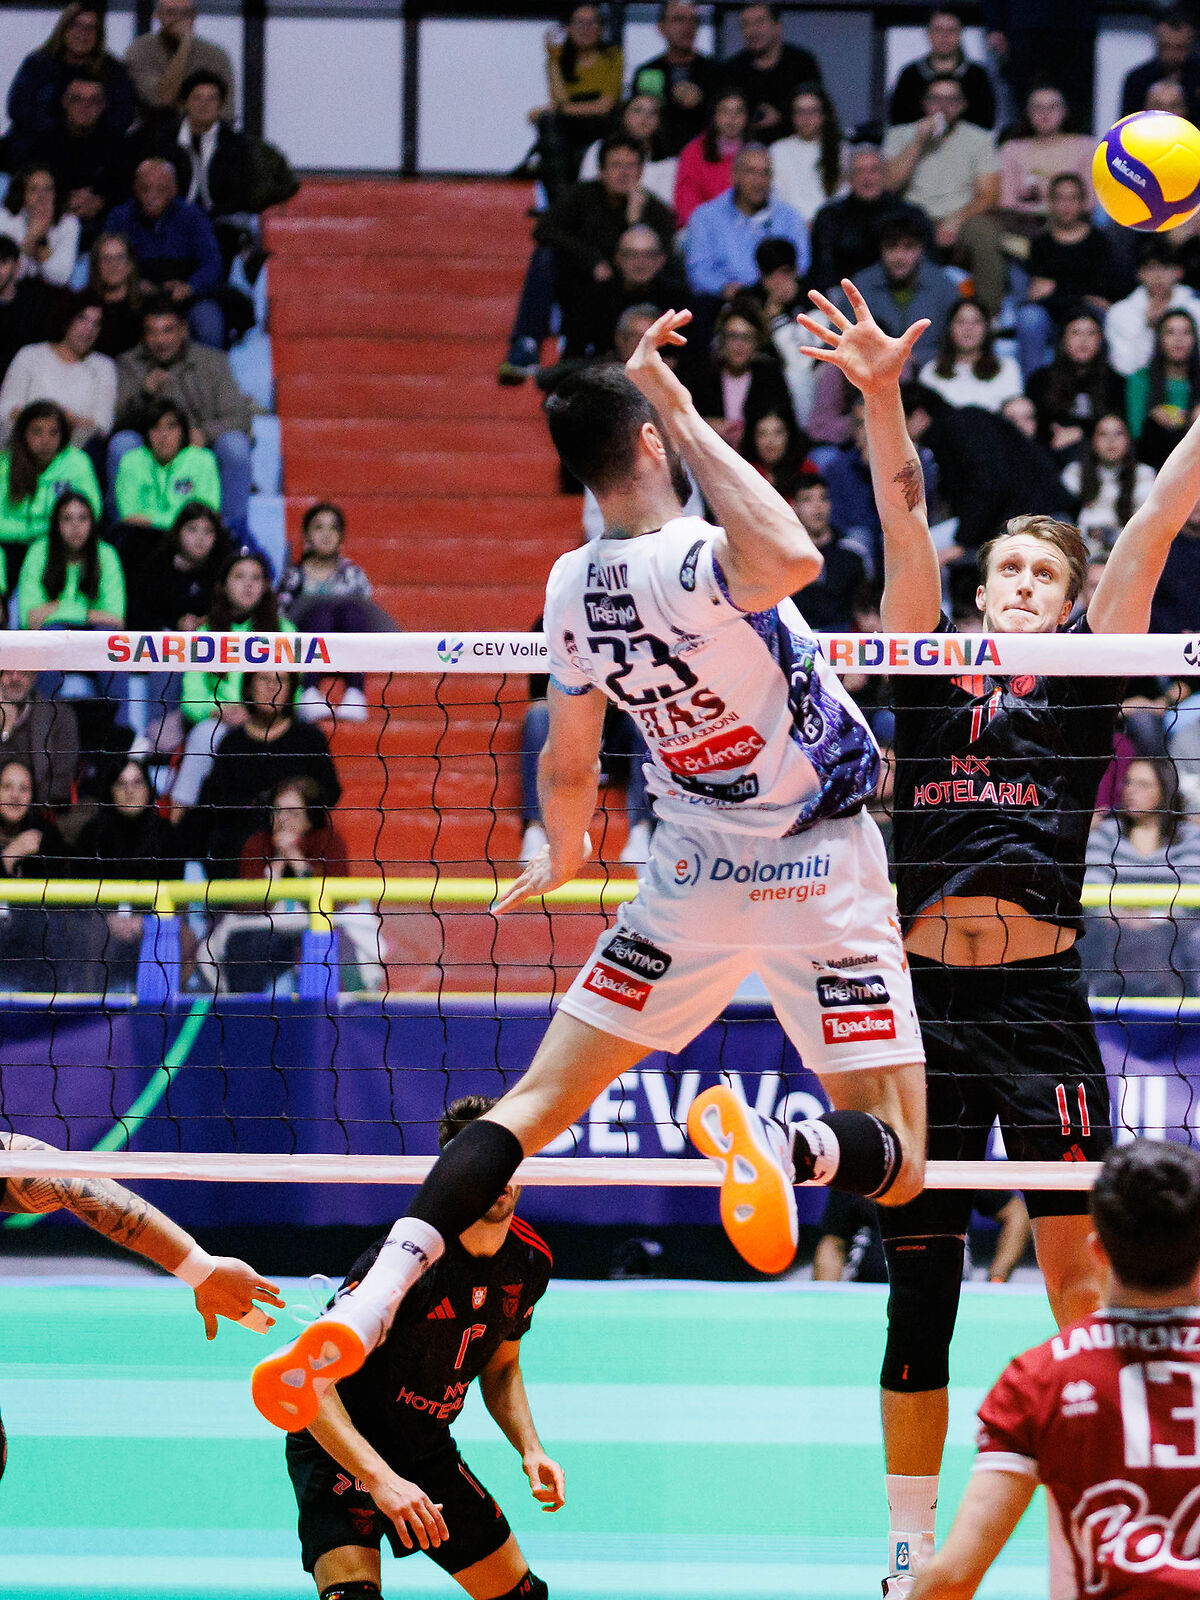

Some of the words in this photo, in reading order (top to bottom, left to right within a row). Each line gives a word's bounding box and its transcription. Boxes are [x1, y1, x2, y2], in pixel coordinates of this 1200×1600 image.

[107, 635, 331, 664] SARDEGNA
[473, 642, 505, 657] CEV
[508, 641, 548, 657] Volle
[830, 639, 1001, 666] RDEGNA
[587, 633, 699, 706] 23
[951, 755, 990, 776] NX
[913, 780, 1039, 807] HOTELARIA
[709, 854, 831, 883] Dolomiti
[749, 881, 826, 903] energia
[608, 938, 665, 972] TRENTINO
[589, 966, 645, 1001] Loacker
[820, 983, 886, 1001] TRENTINO
[825, 1016, 892, 1038] Loacker
[1055, 1082, 1091, 1137] 11
